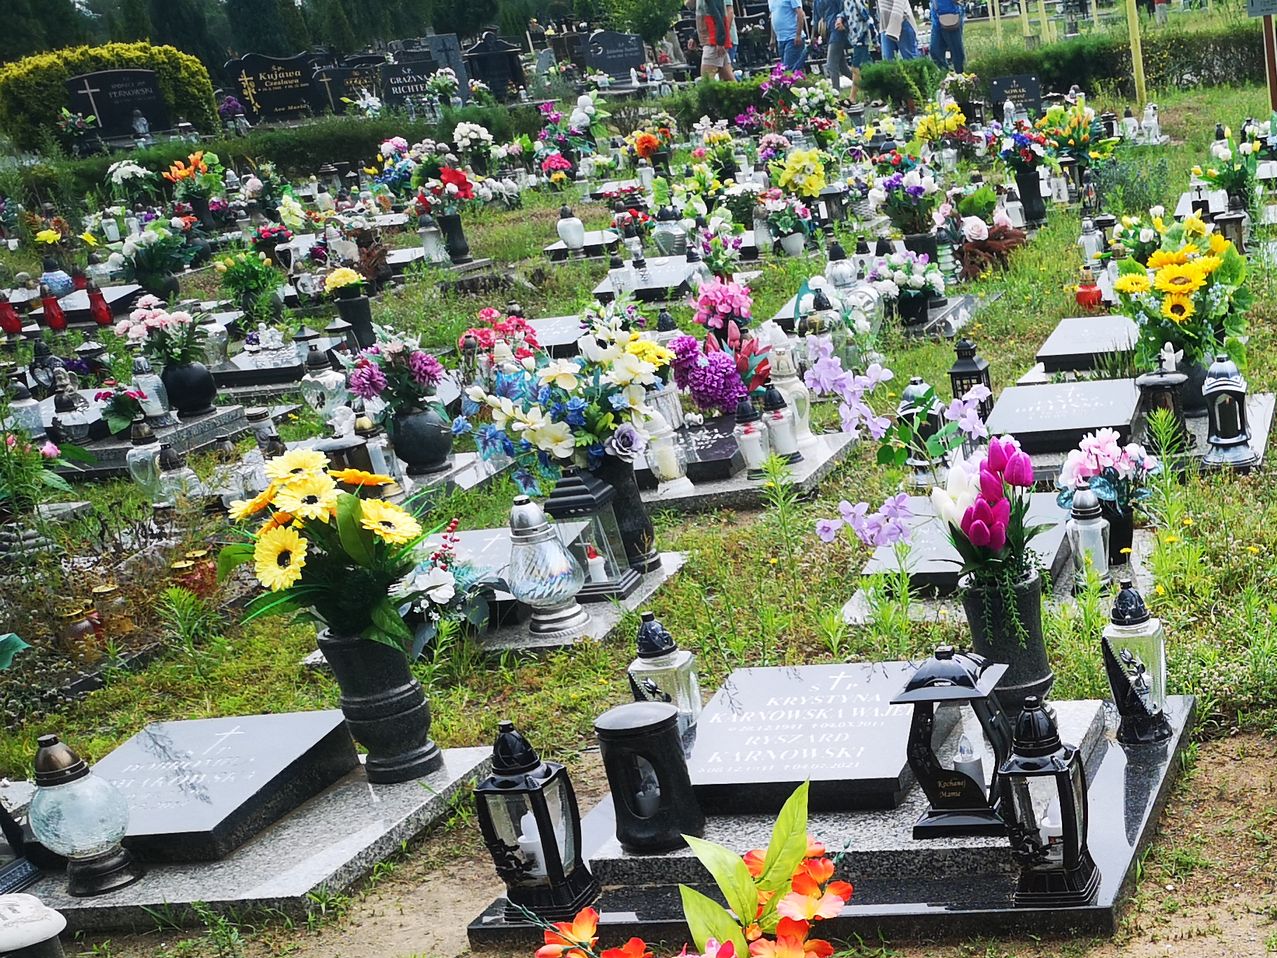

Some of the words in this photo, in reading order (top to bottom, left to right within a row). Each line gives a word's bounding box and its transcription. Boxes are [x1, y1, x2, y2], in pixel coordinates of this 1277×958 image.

[259, 70, 302, 81] Kujawa
[766, 693, 882, 707] KRYSTYNA
[708, 708, 844, 724] KARNOWSKA
[744, 732, 850, 746] RYSZARD
[707, 746, 866, 763] KARNOWSKI
